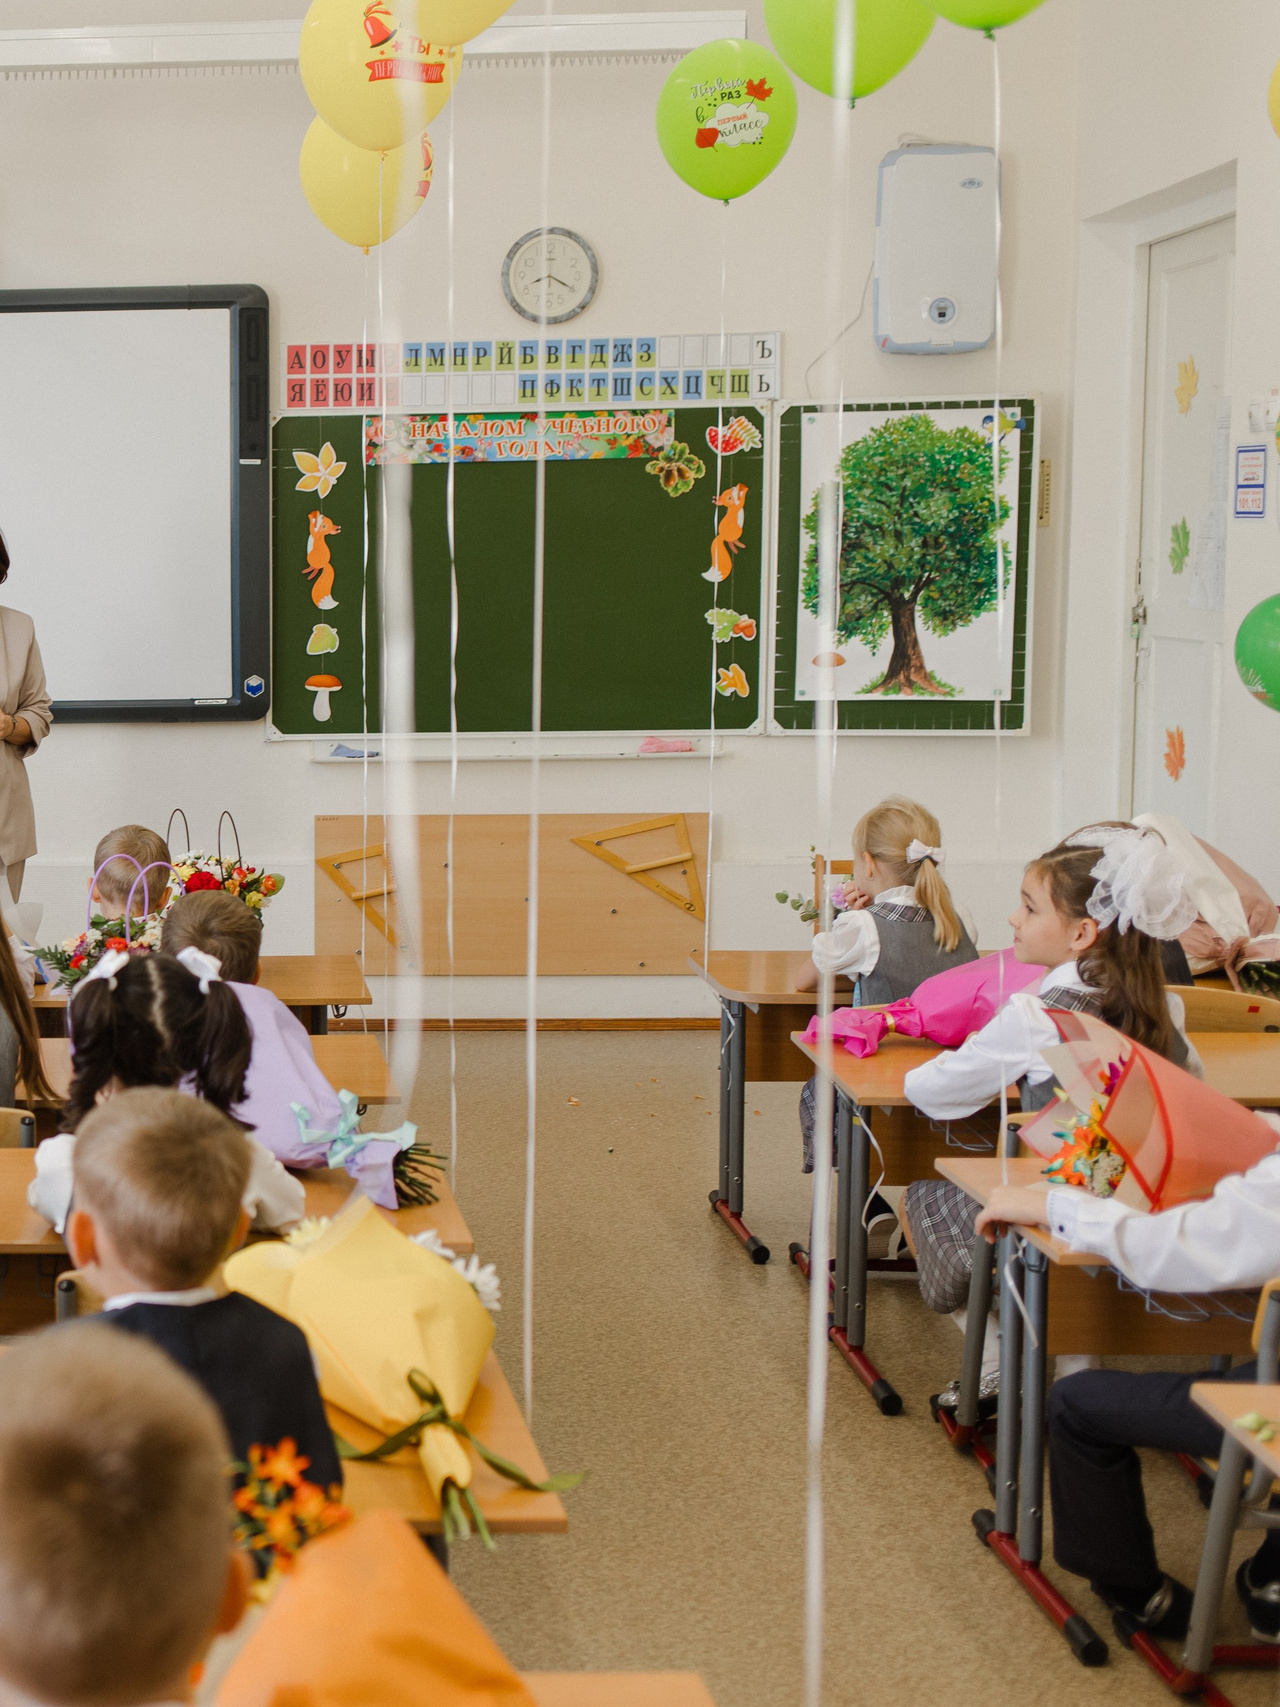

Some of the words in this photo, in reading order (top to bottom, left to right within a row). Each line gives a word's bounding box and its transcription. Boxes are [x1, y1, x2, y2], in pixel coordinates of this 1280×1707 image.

[720, 90, 741, 101] РАЗ
[695, 106, 709, 124] в
[717, 112, 747, 125] ПЕРВЫЙ
[718, 119, 764, 138] класс
[290, 351, 304, 369] А
[312, 350, 326, 369] О
[336, 350, 350, 368] У
[357, 349, 375, 368] Ы
[405, 348, 420, 367] Л
[428, 348, 445, 366] М
[453, 347, 466, 366] Н
[475, 347, 487, 365] Р
[498, 342, 513, 365] Й
[522, 346, 534, 365] Б
[546, 345, 559, 364] В
[570, 345, 582, 363] Г
[591, 344, 606, 368] Д
[613, 343, 632, 363] Ж
[639, 343, 652, 362] З
[756, 340, 772, 359] Ъ
[290, 383, 305, 402] Я
[314, 379, 327, 402] Ё
[333, 382, 352, 402] Ю
[359, 382, 374, 401] И
[521, 379, 537, 398] П
[544, 379, 560, 398] Ф
[568, 378, 583, 397] К
[592, 378, 605, 397] Т
[613, 377, 631, 396] Ш
[639, 376, 652, 396] С
[661, 376, 677, 396] Х
[685, 375, 701, 398] Ц
[709, 375, 724, 394] Ч
[730, 374, 750, 395] Щ
[757, 374, 771, 392] Ь
[410, 420, 526, 439] НАЧАЛОМ
[537, 416, 659, 436] УЧЕБНОГО
[496, 440, 564, 458] ГОДА!
